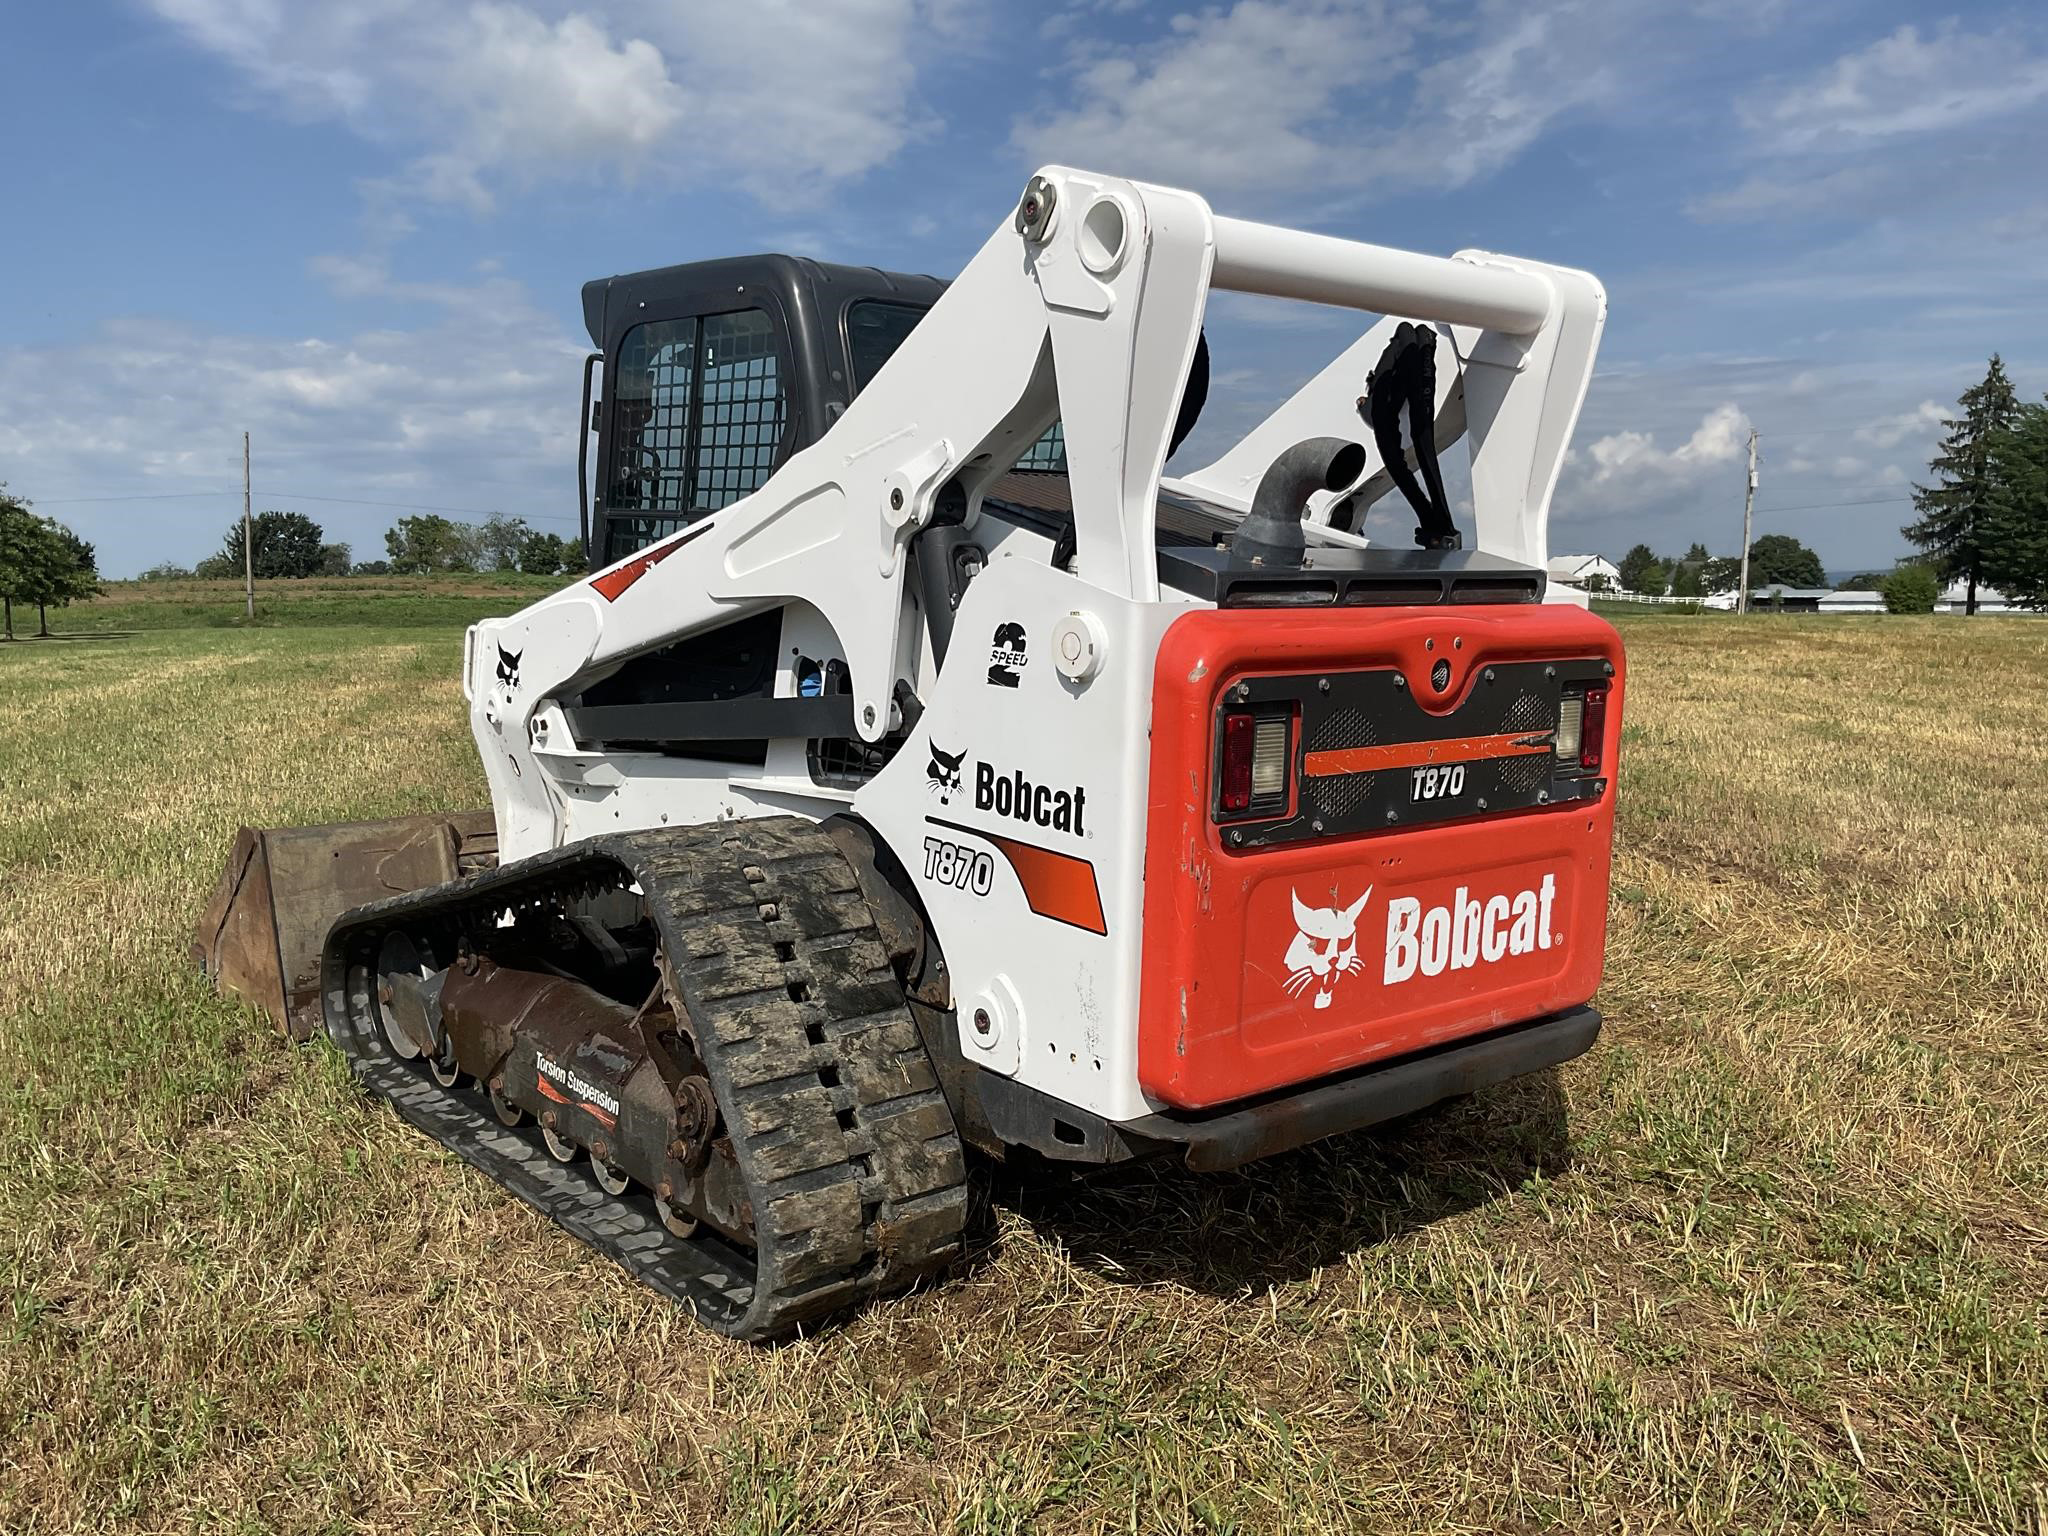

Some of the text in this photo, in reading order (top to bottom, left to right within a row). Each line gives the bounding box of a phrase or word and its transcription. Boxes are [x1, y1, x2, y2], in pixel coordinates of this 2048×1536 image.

[991, 649, 1029, 667] SPEED
[974, 760, 1086, 838] Bobcat
[1413, 764, 1465, 801] T870
[923, 835, 995, 897] T870
[1383, 873, 1556, 986] Bobcat
[536, 1050, 619, 1116] Torsion Suspension
